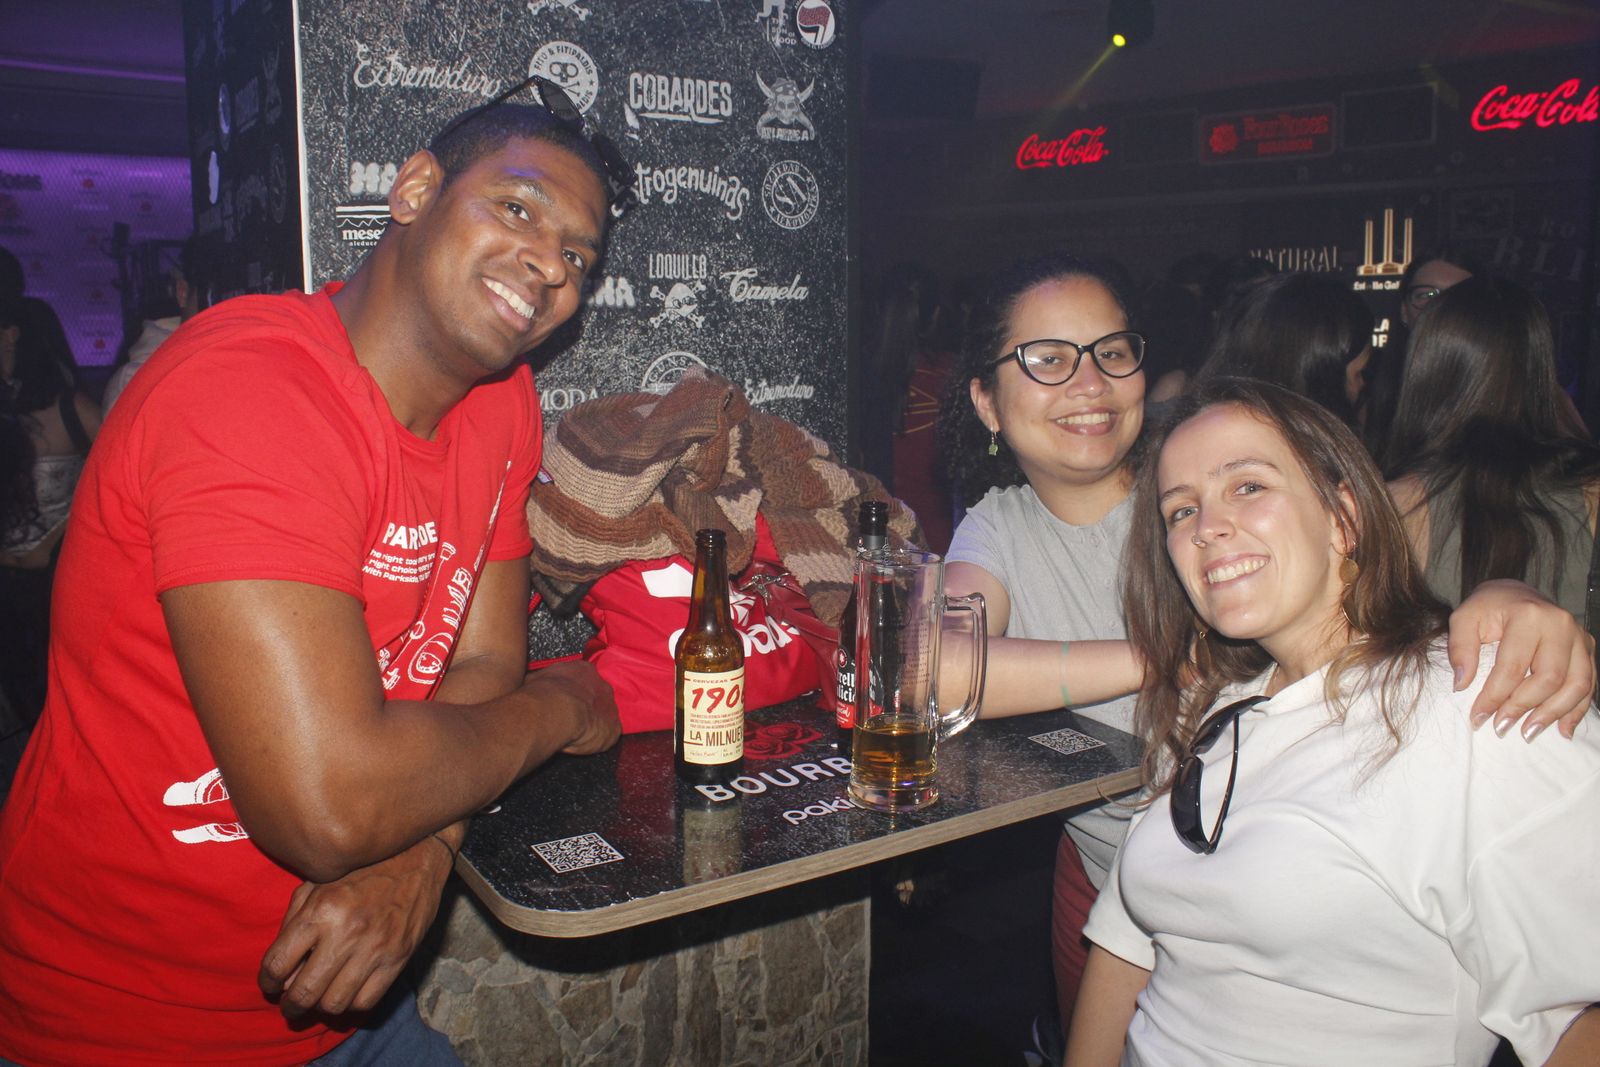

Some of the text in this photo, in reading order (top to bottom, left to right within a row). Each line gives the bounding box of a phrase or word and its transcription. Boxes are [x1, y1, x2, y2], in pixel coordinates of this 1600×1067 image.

[628, 71, 732, 124] COBARDES
[648, 253, 707, 280] LOQUILLO
[719, 268, 810, 302] Camela
[649, 356, 688, 382] GUNS
[690, 730, 702, 741] LA
[694, 755, 853, 802] BOURB
